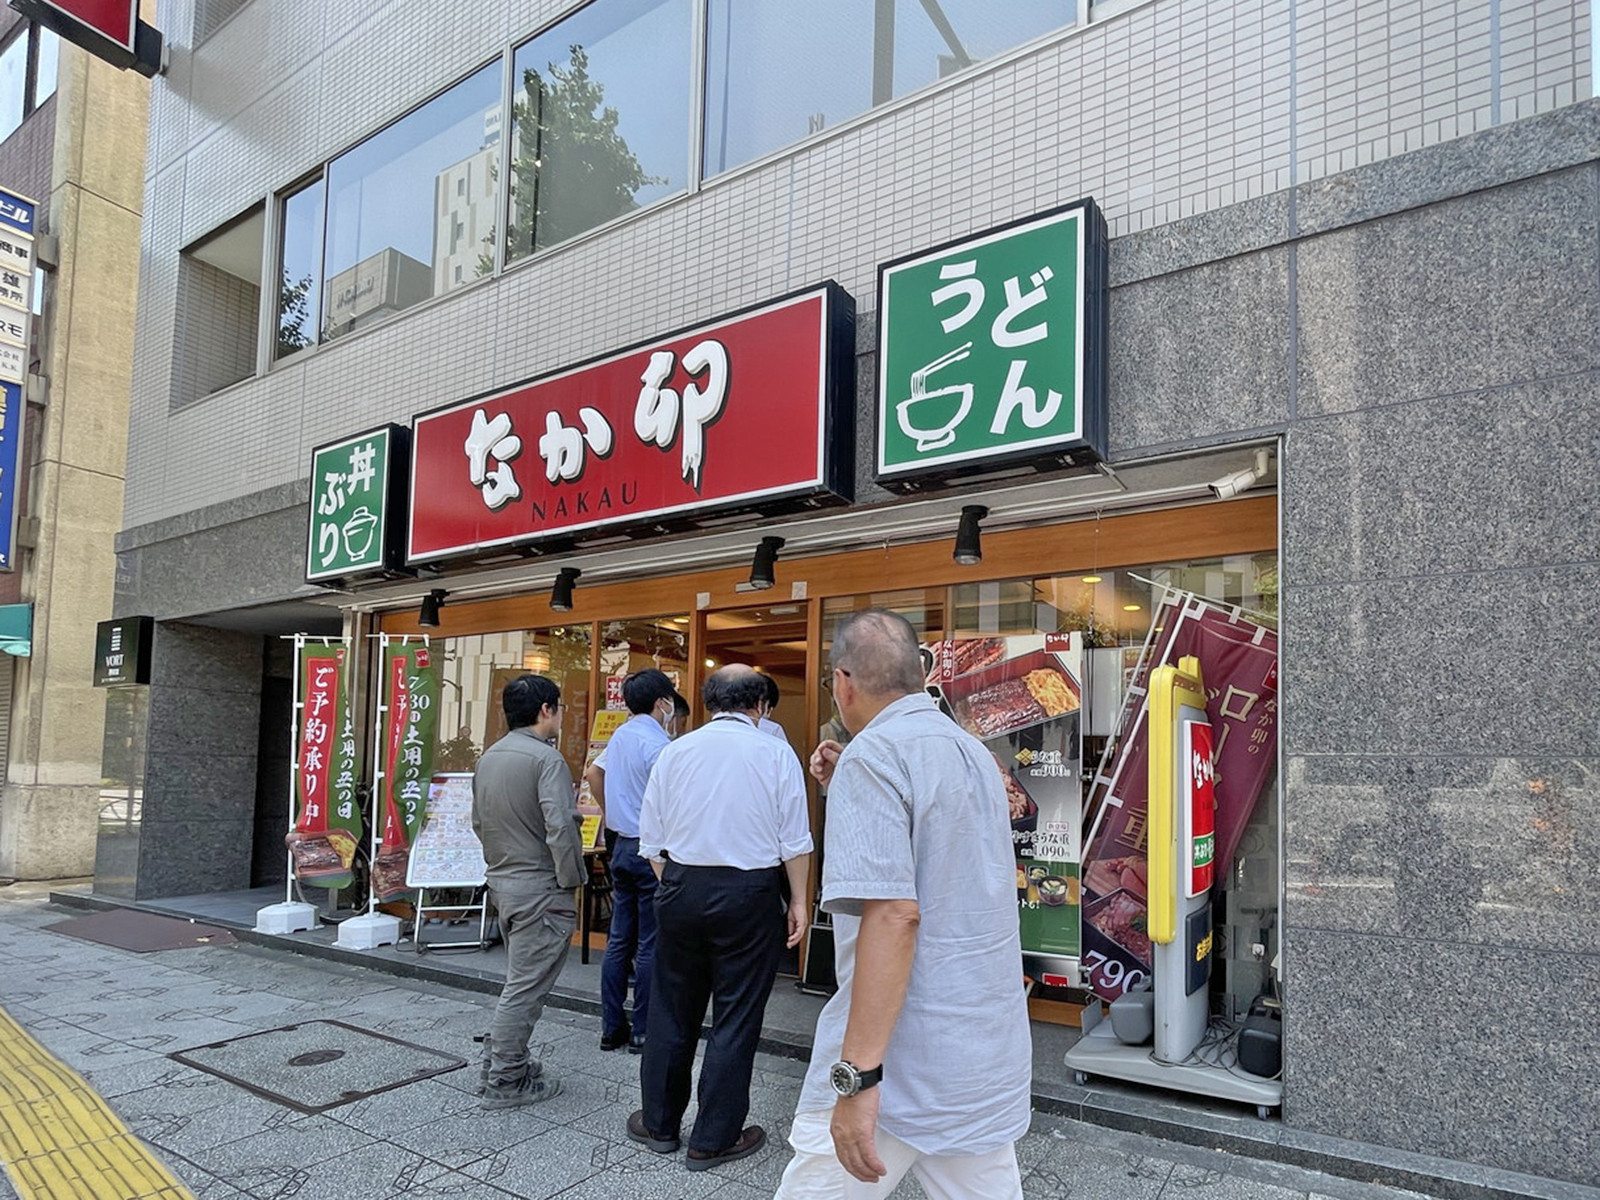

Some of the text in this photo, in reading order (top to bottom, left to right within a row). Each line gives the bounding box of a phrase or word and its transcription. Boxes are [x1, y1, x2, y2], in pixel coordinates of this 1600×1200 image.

[465, 339, 731, 511] なか卯
[931, 259, 1063, 435] うどん
[532, 481, 638, 522] NAKAU
[304, 667, 335, 826] ご予約承り中
